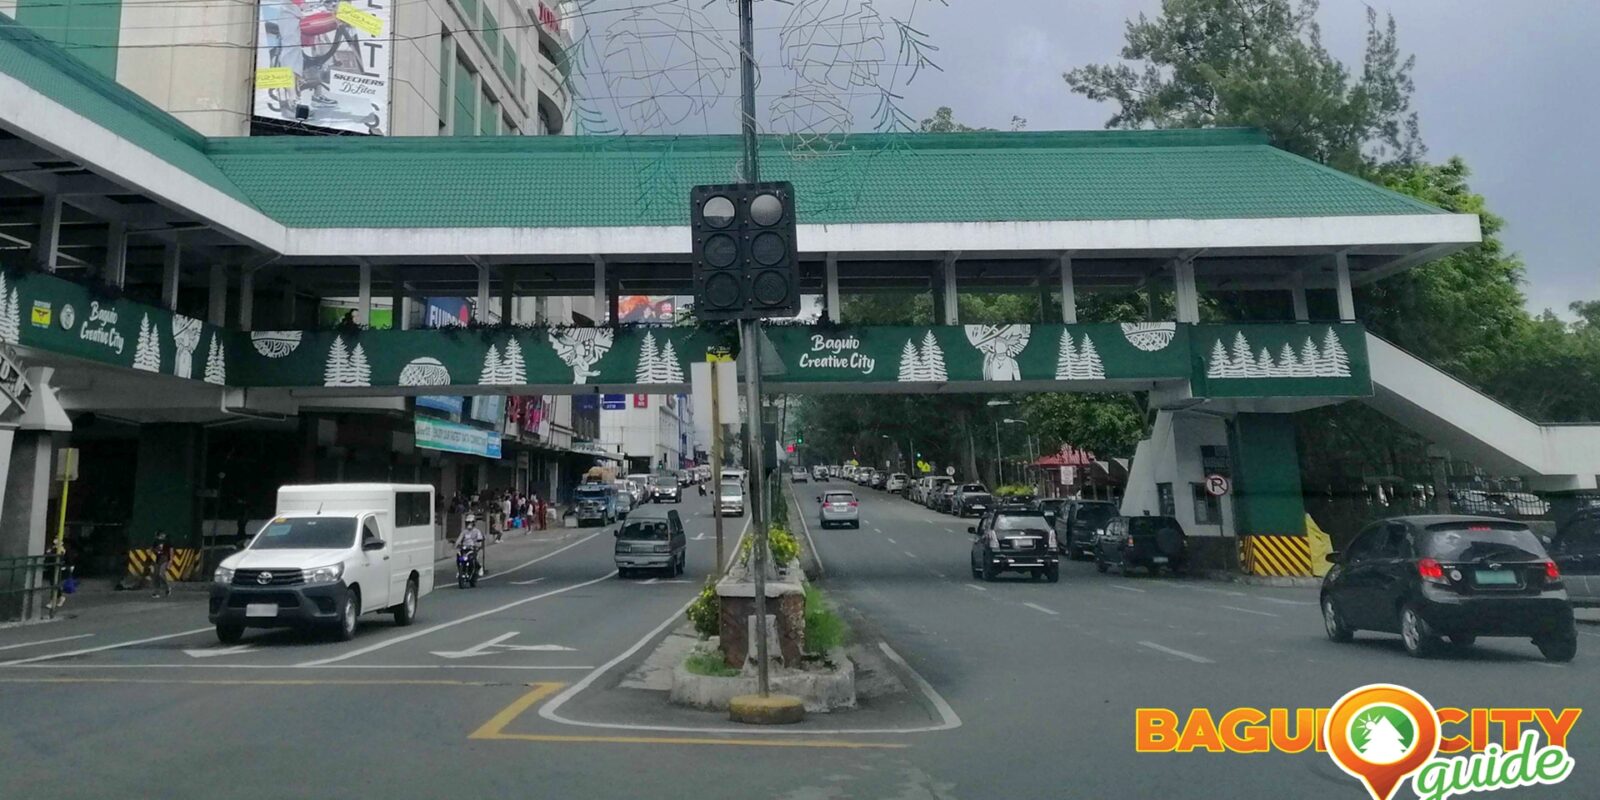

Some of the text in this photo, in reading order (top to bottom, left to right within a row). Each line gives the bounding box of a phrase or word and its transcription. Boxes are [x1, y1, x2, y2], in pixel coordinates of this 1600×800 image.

[333, 74, 385, 86] SKECHERS
[89, 300, 118, 327] Baguio
[80, 321, 124, 354] Creative City
[810, 335, 860, 354] Baguio
[799, 352, 876, 374] Creative City
